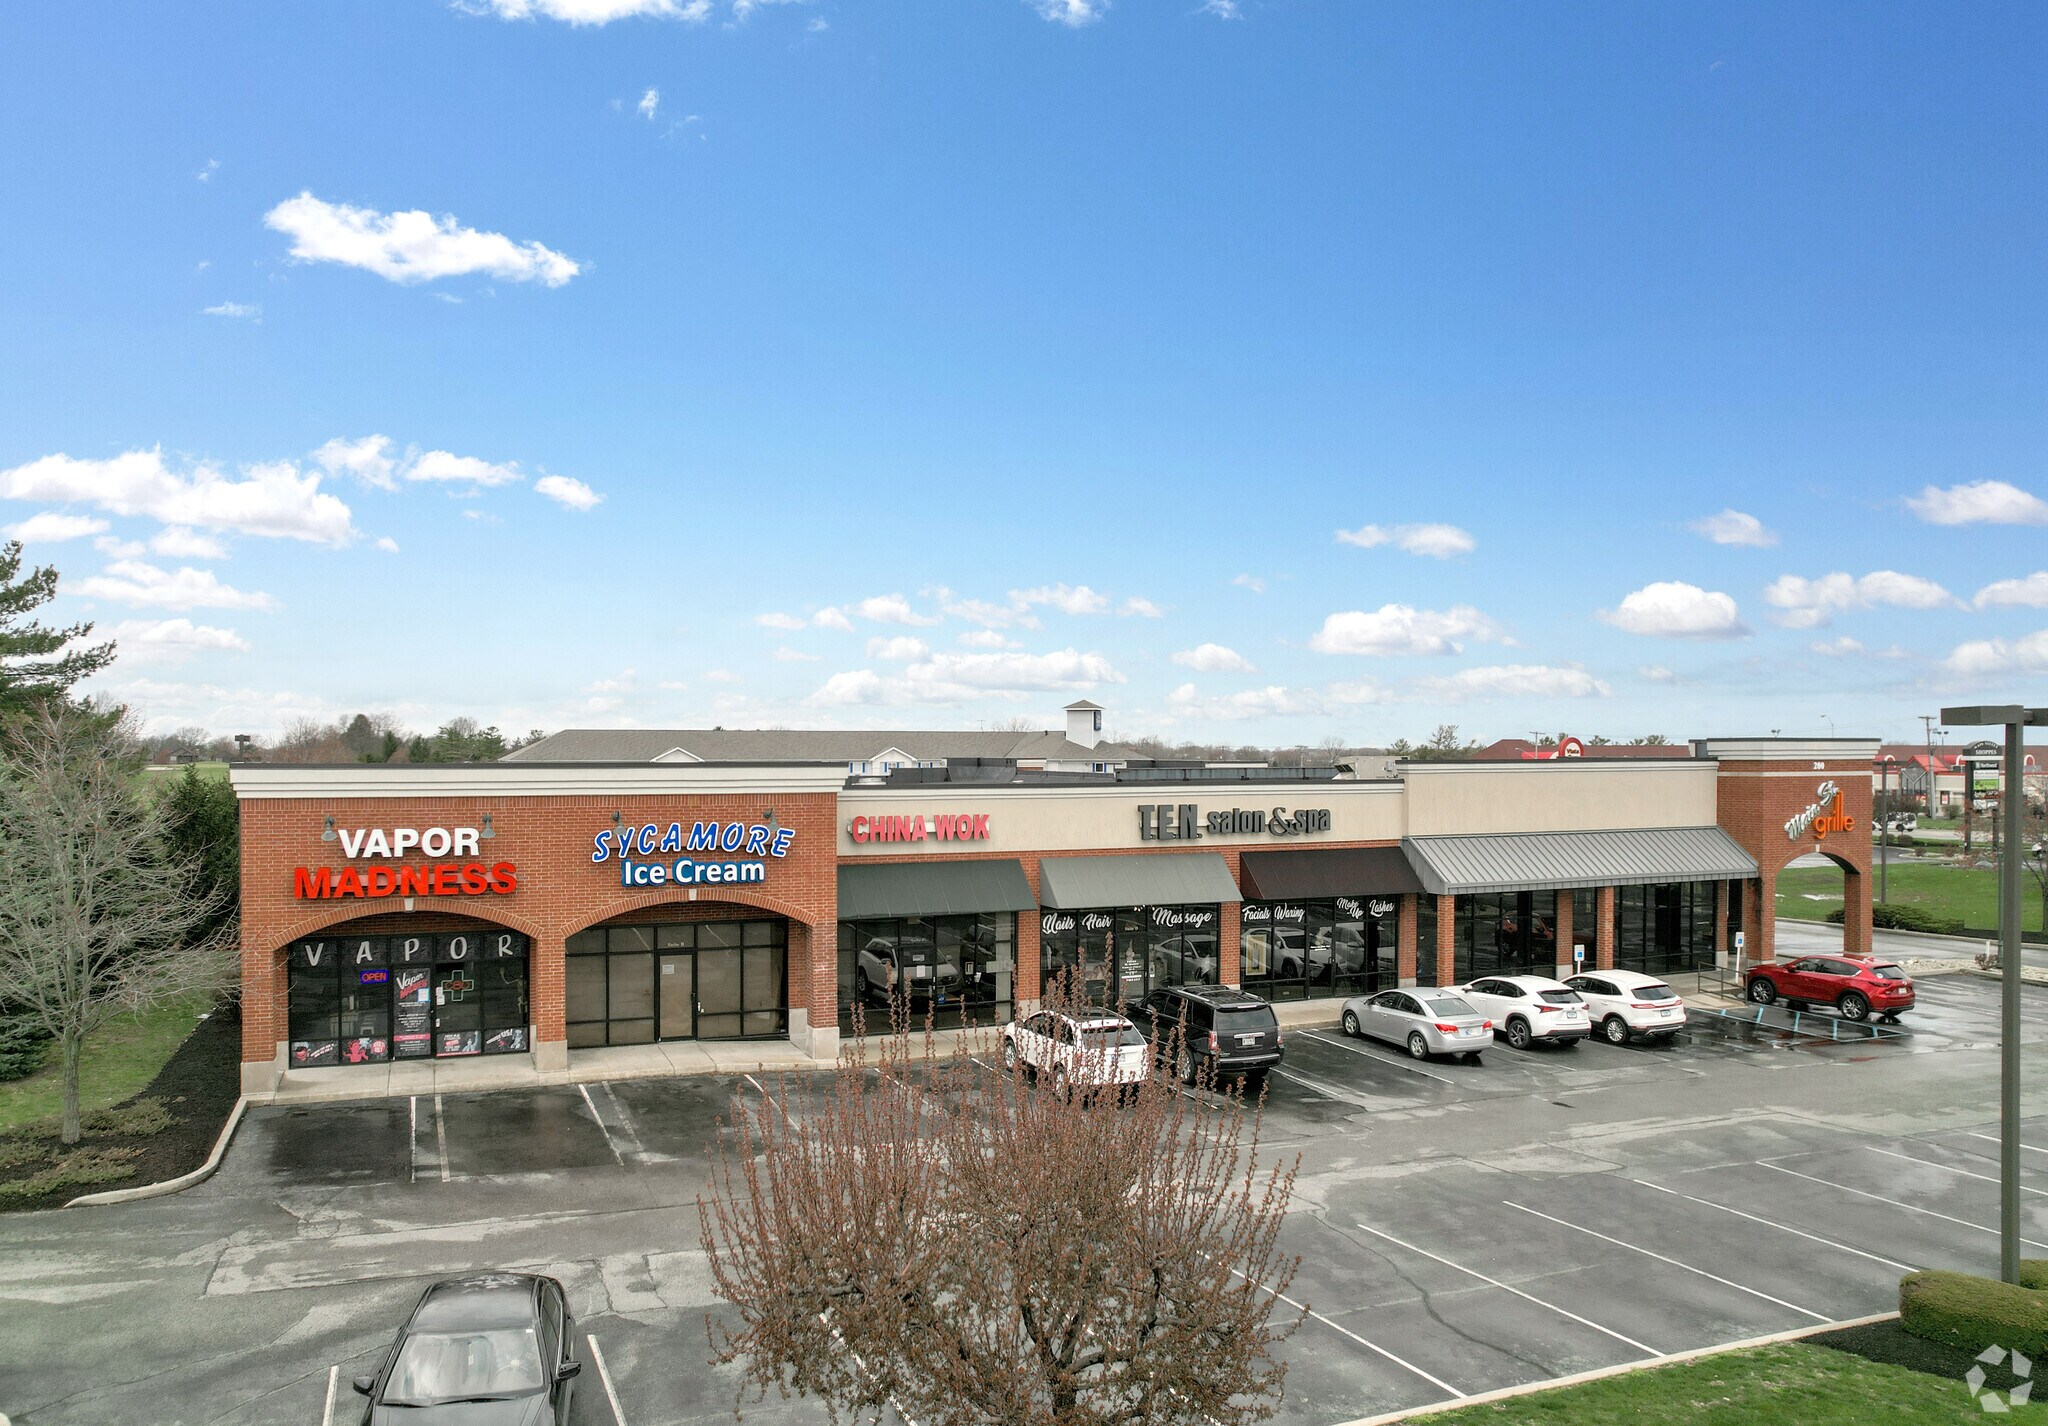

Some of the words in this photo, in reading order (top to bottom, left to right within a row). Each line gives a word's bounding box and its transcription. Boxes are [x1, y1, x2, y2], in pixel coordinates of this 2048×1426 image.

[1206, 807, 1266, 835] salon
[1268, 806, 1300, 837] &
[1293, 808, 1331, 834] spa
[1783, 803, 1820, 841] Main
[1813, 790, 1855, 839] grille
[851, 815, 929, 844] CHINA
[934, 814, 990, 841] WOK
[337, 827, 480, 859] VAPOR
[592, 823, 795, 862] SYCAMORE
[293, 862, 518, 899] MADNESS
[622, 860, 666, 886] Ice
[674, 859, 766, 885] Cream
[1241, 905, 1272, 923] Facials
[1273, 902, 1306, 923] Waxing
[1336, 897, 1360, 912] Make
[1346, 905, 1364, 920] Up
[1368, 899, 1396, 918] Lashes
[1042, 912, 1077, 935] Nails
[1081, 912, 1113, 931] Hair
[1151, 907, 1213, 929] Massage
[362, 972, 387, 983] OPEN
[396, 972, 424, 990] Vapor
